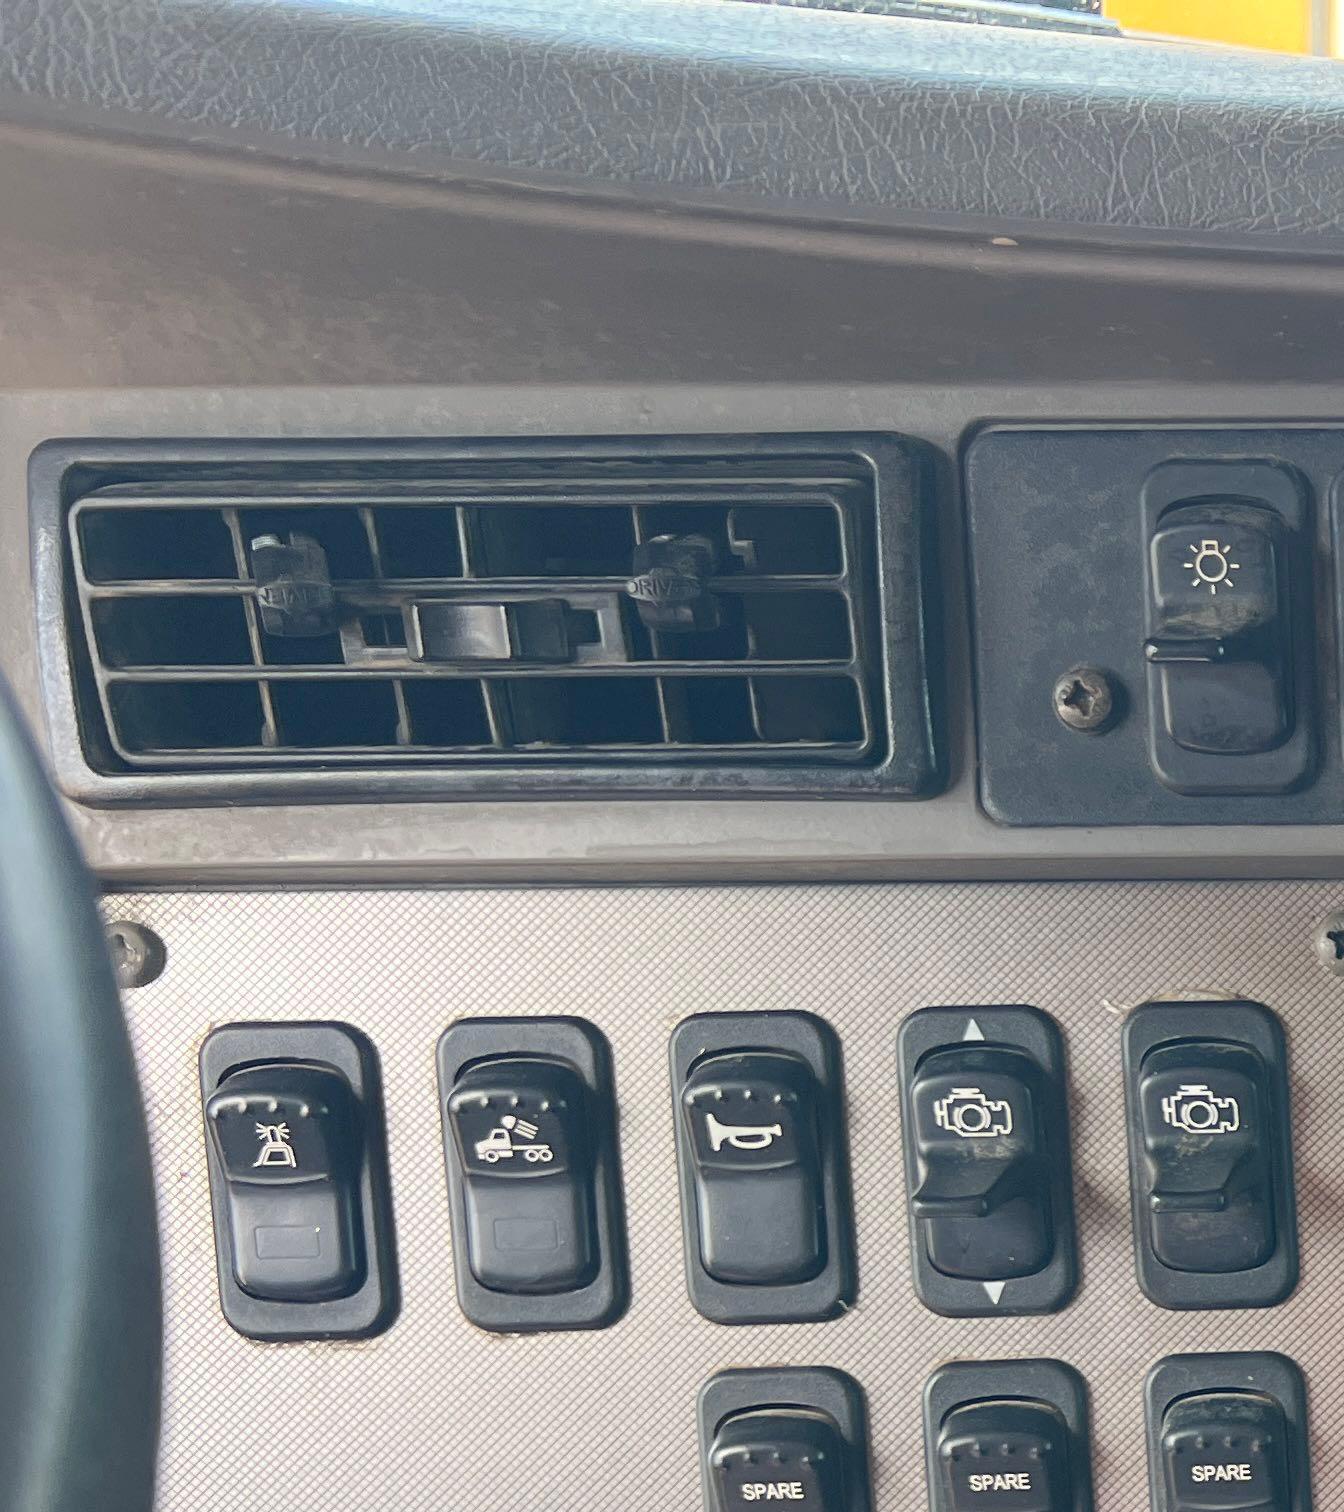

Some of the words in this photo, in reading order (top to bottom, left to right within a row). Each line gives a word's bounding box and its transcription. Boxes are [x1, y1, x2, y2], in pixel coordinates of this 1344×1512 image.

[968, 1471, 1031, 1493] SPARE
[1190, 1463, 1252, 1483] SPARE
[741, 1481, 805, 1501] SPARE
